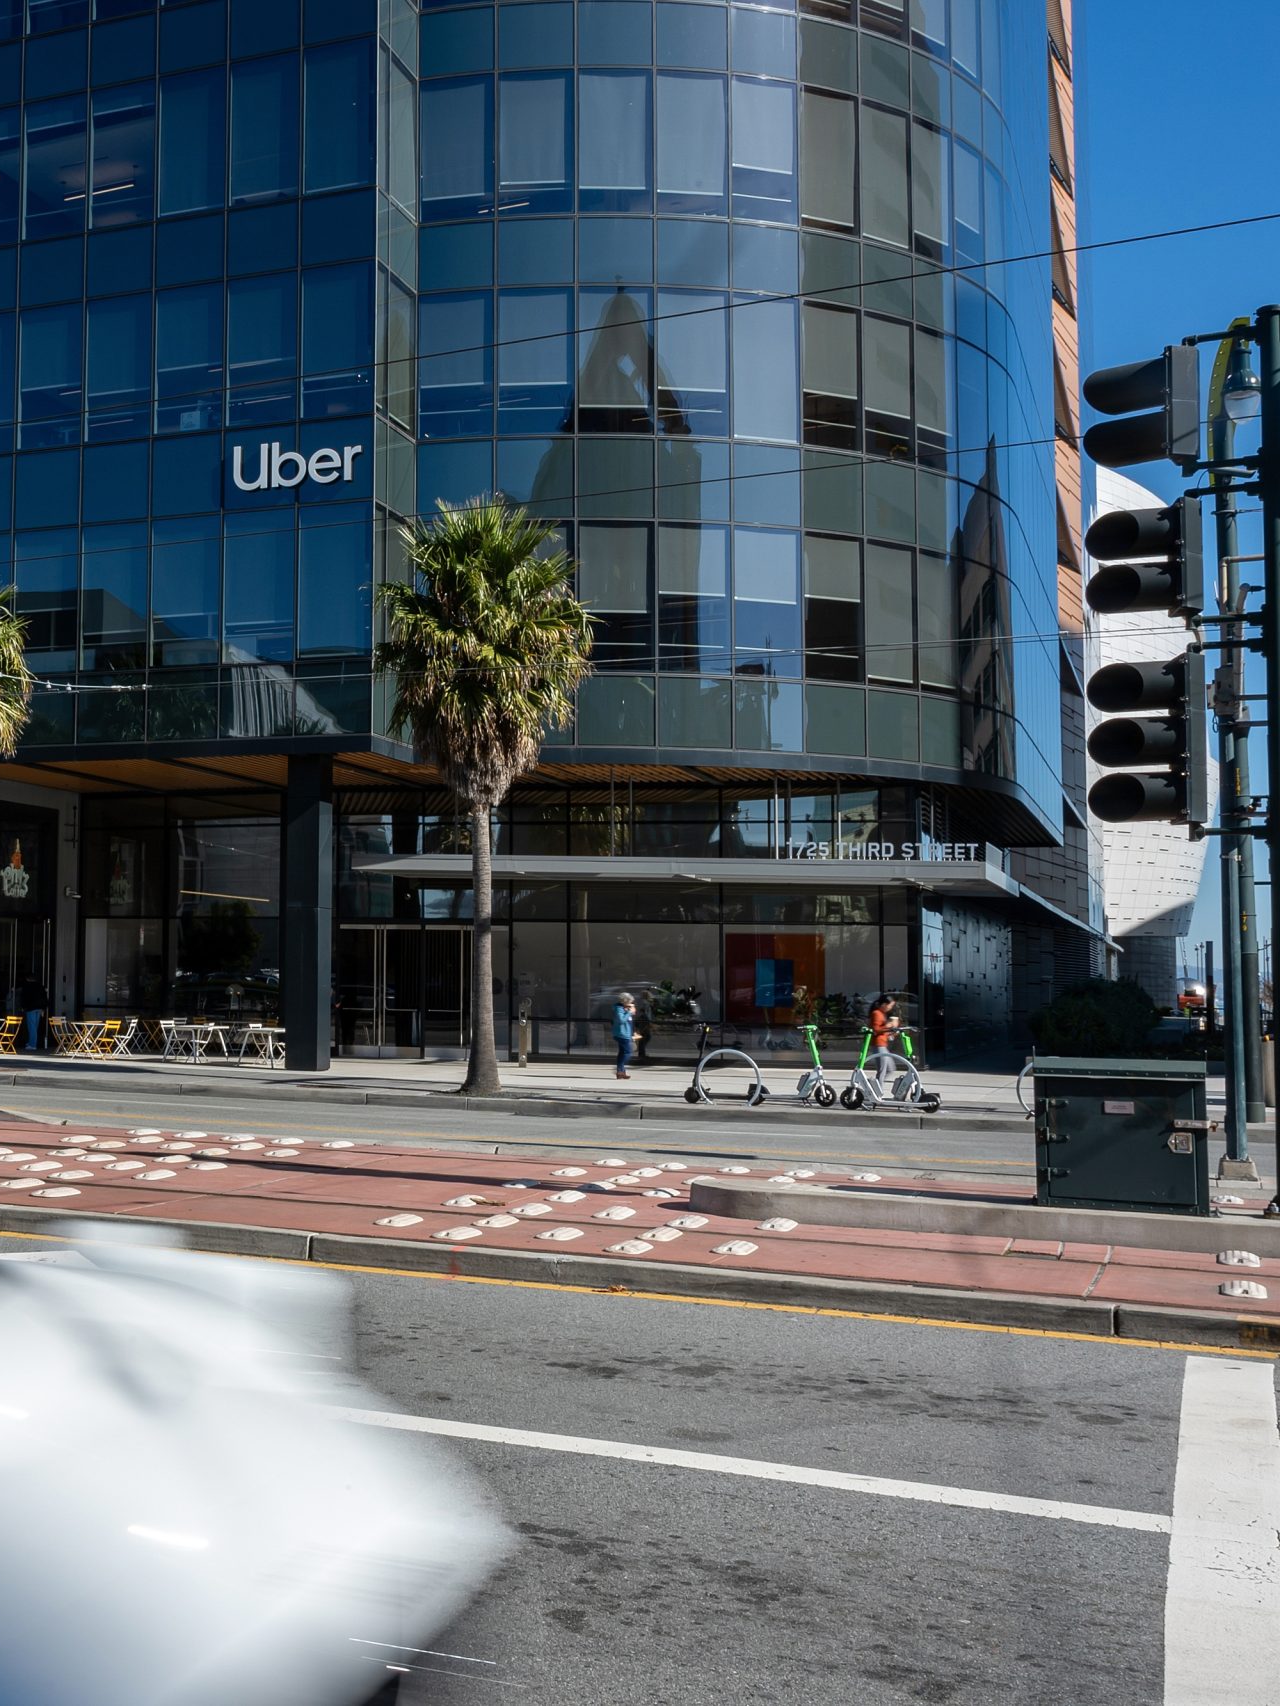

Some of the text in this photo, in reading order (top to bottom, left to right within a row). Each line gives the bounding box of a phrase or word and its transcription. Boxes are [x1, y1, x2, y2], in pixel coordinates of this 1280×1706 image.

[233, 442, 362, 491] Uber
[787, 841, 978, 859] 1725 THIRD STREET
